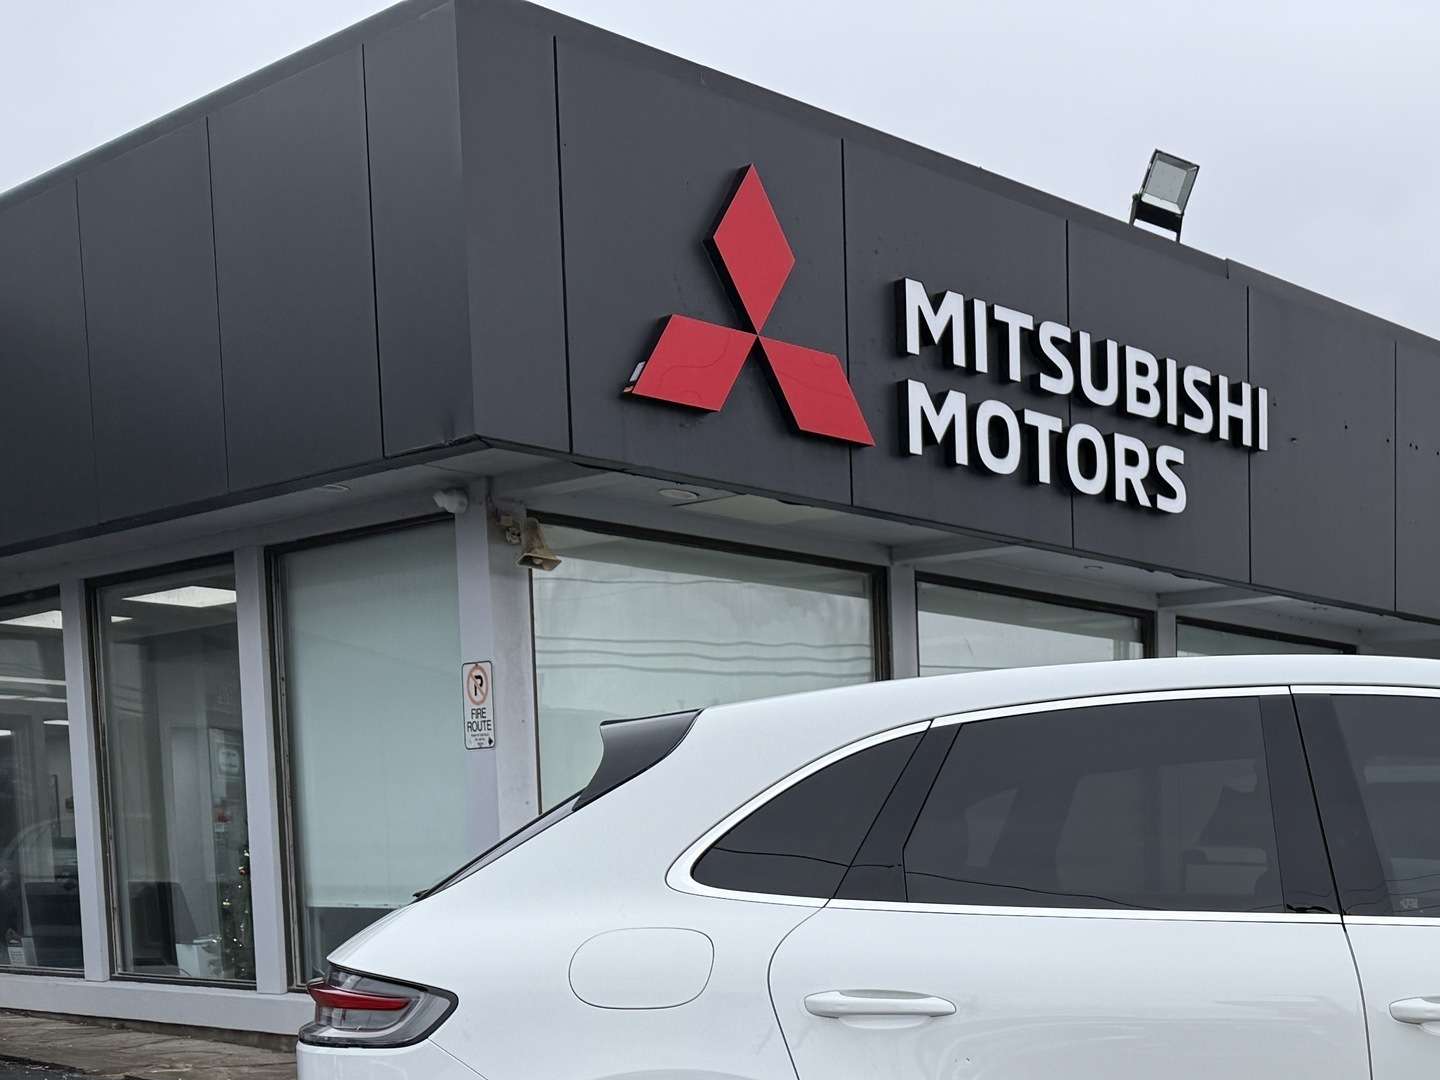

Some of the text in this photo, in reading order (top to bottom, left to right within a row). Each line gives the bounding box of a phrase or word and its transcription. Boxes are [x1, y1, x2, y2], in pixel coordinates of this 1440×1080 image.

[903, 277, 1269, 451] MITSUBISHI
[906, 378, 1187, 515] MOTORS
[467, 719, 492, 732] ROUTE
[471, 707, 487, 719] FIRE
